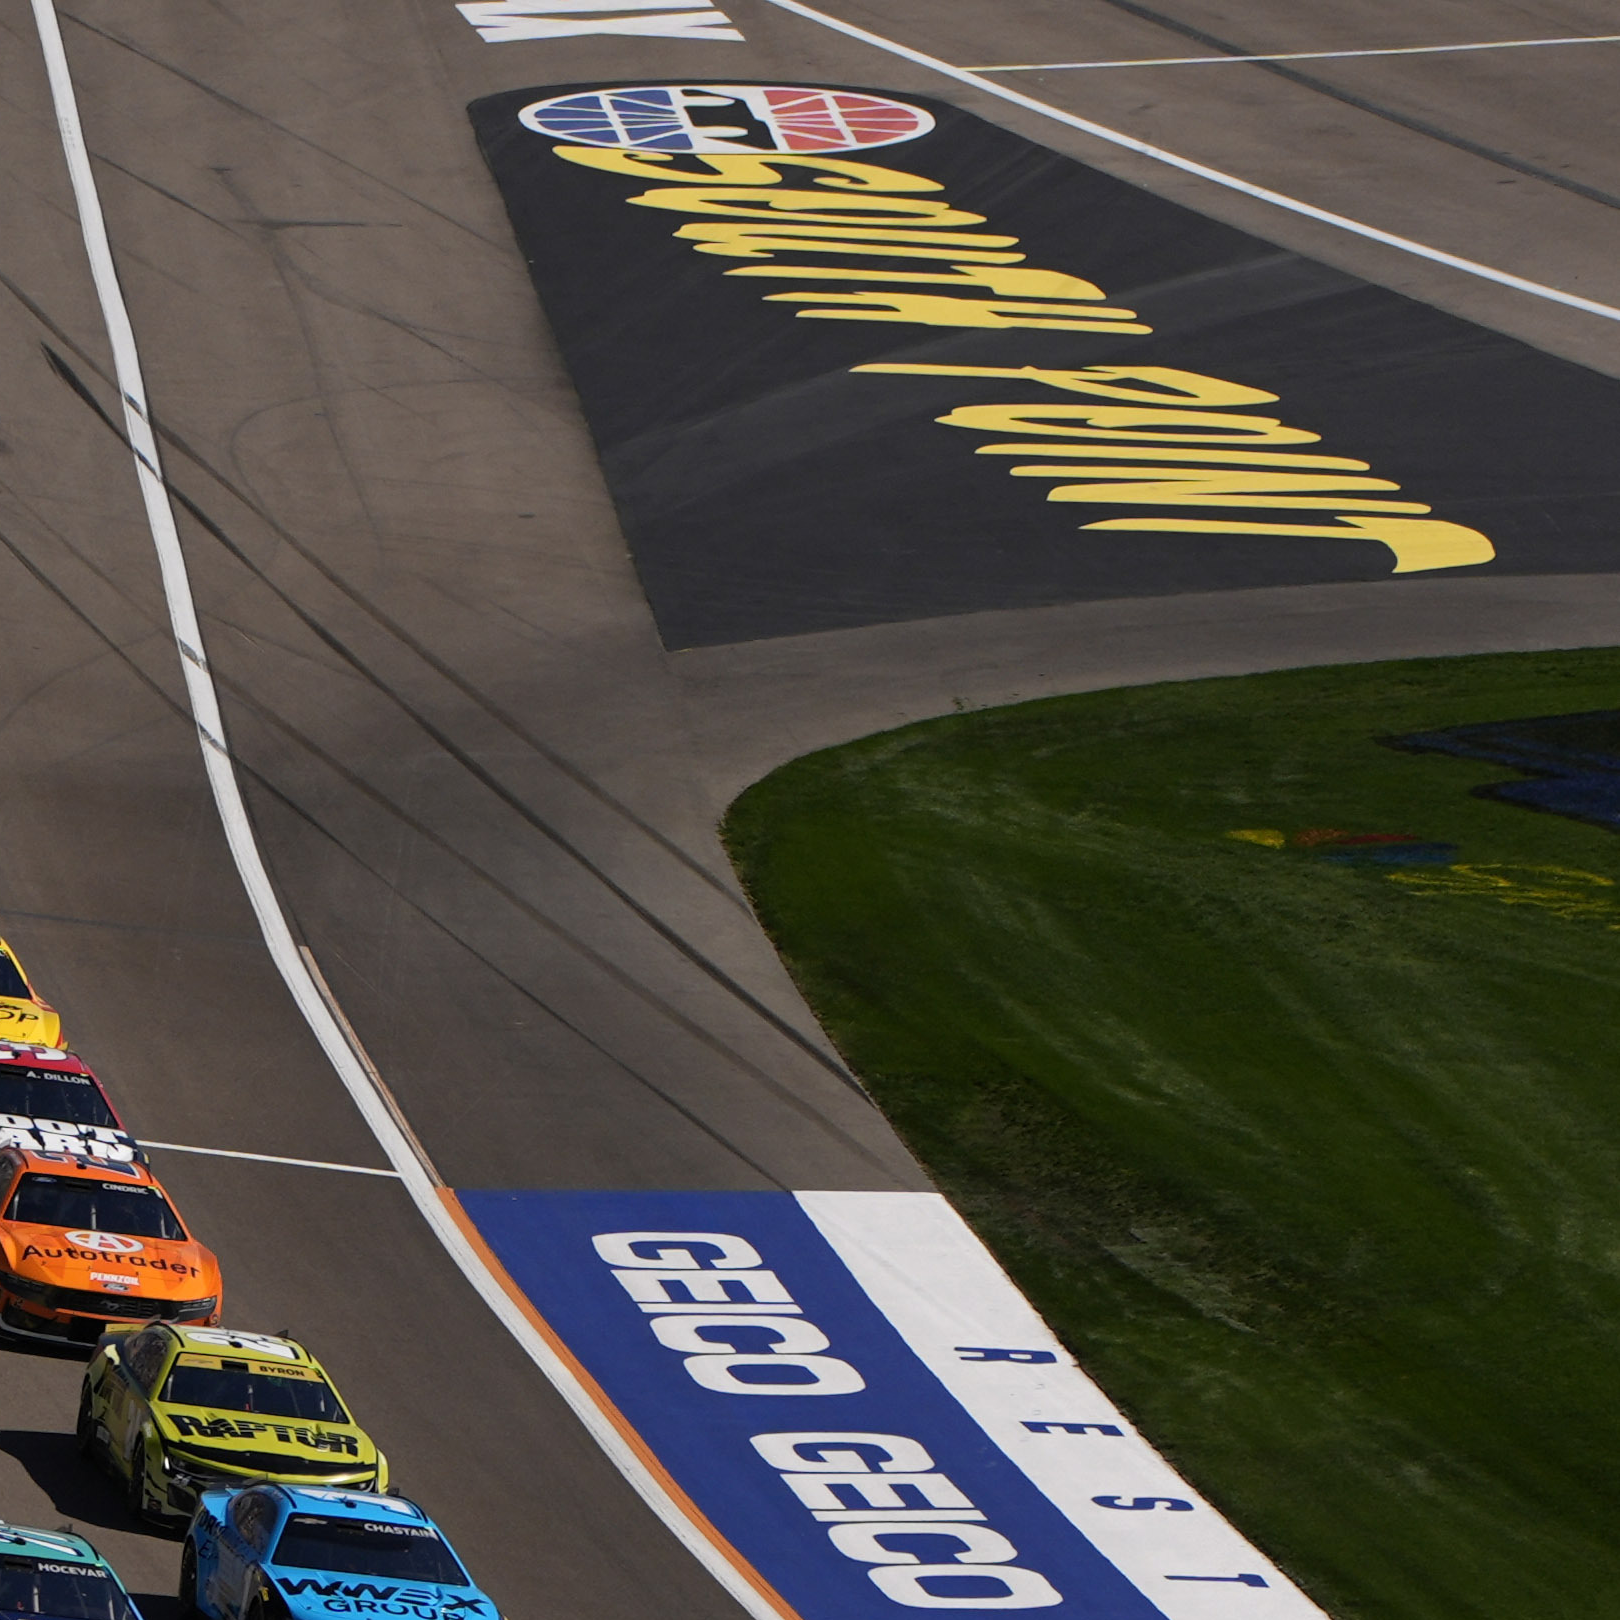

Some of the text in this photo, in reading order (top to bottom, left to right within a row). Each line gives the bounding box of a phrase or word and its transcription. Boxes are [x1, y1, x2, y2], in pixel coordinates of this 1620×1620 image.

[553, 145, 1495, 574] SOUTH POINT
[26, 1070, 91, 1086] A. DILLON
[102, 1182, 148, 1195] CINDRIC
[20, 1244, 201, 1280] Autotrader
[591, 1231, 865, 1397] GEICO
[258, 1364, 305, 1378] BYRON
[166, 1414, 360, 1457] RAPTOR
[363, 1523, 435, 1540] CHASTAIN
[748, 1431, 1064, 1610] GEICO
[37, 1562, 108, 1579] HOCEVAR
[275, 1576, 498, 1615] WWEX
